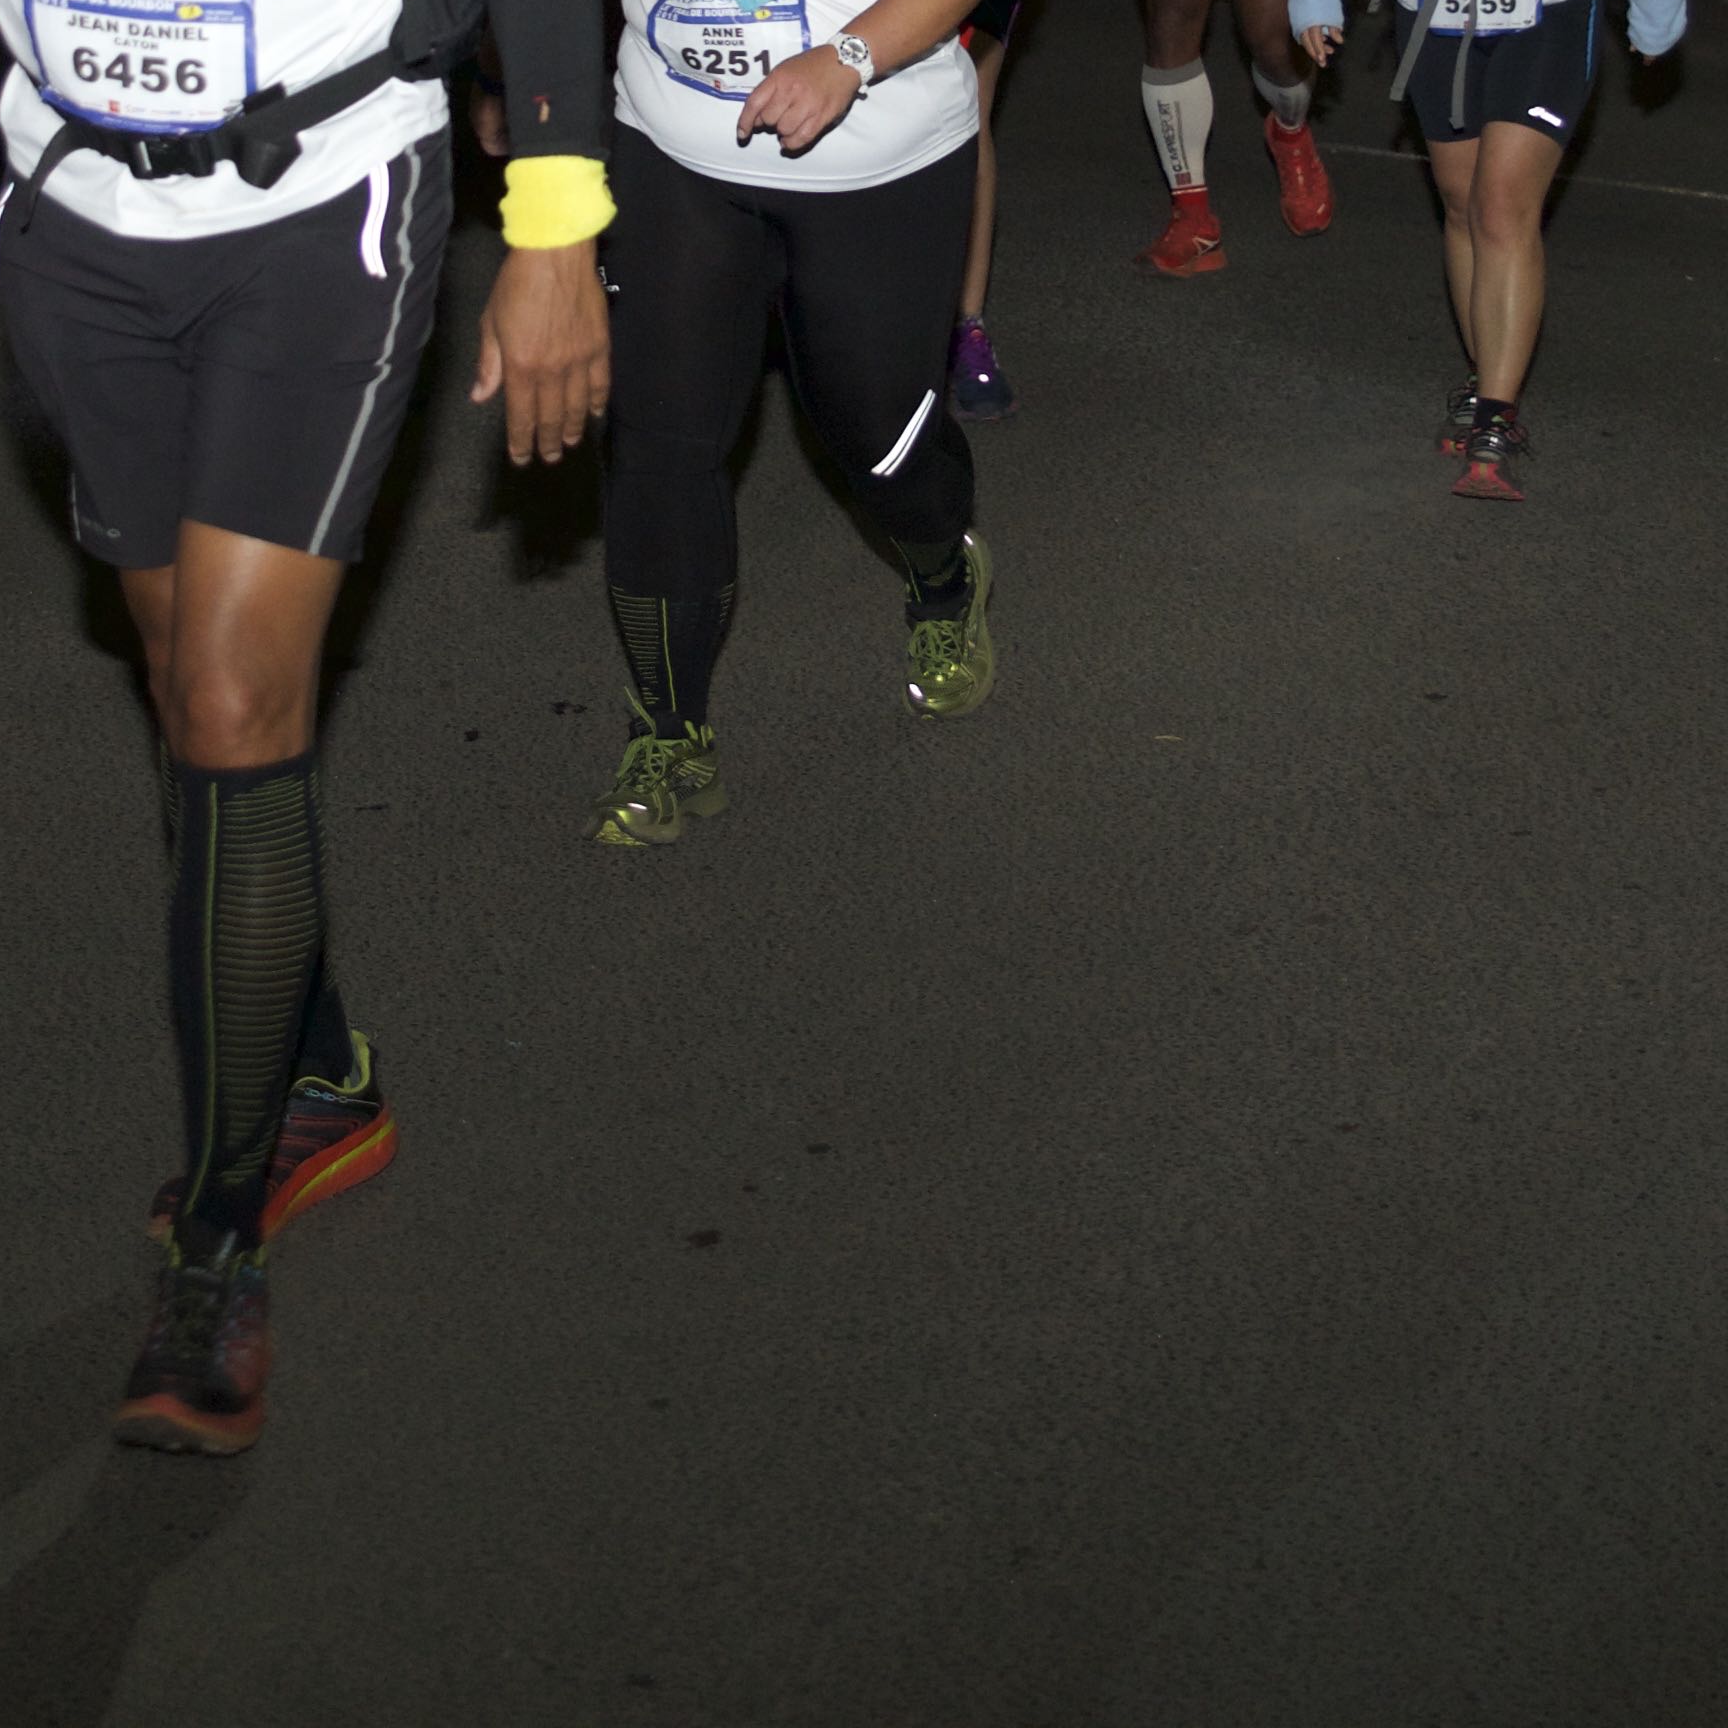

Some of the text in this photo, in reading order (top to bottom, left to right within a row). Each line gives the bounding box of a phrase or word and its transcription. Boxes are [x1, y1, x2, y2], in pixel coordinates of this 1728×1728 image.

[68, 13, 210, 42] JEAN DANIEL
[702, 27, 745, 38] ANNE
[71, 45, 208, 95] 6456
[681, 46, 771, 77] 6251
